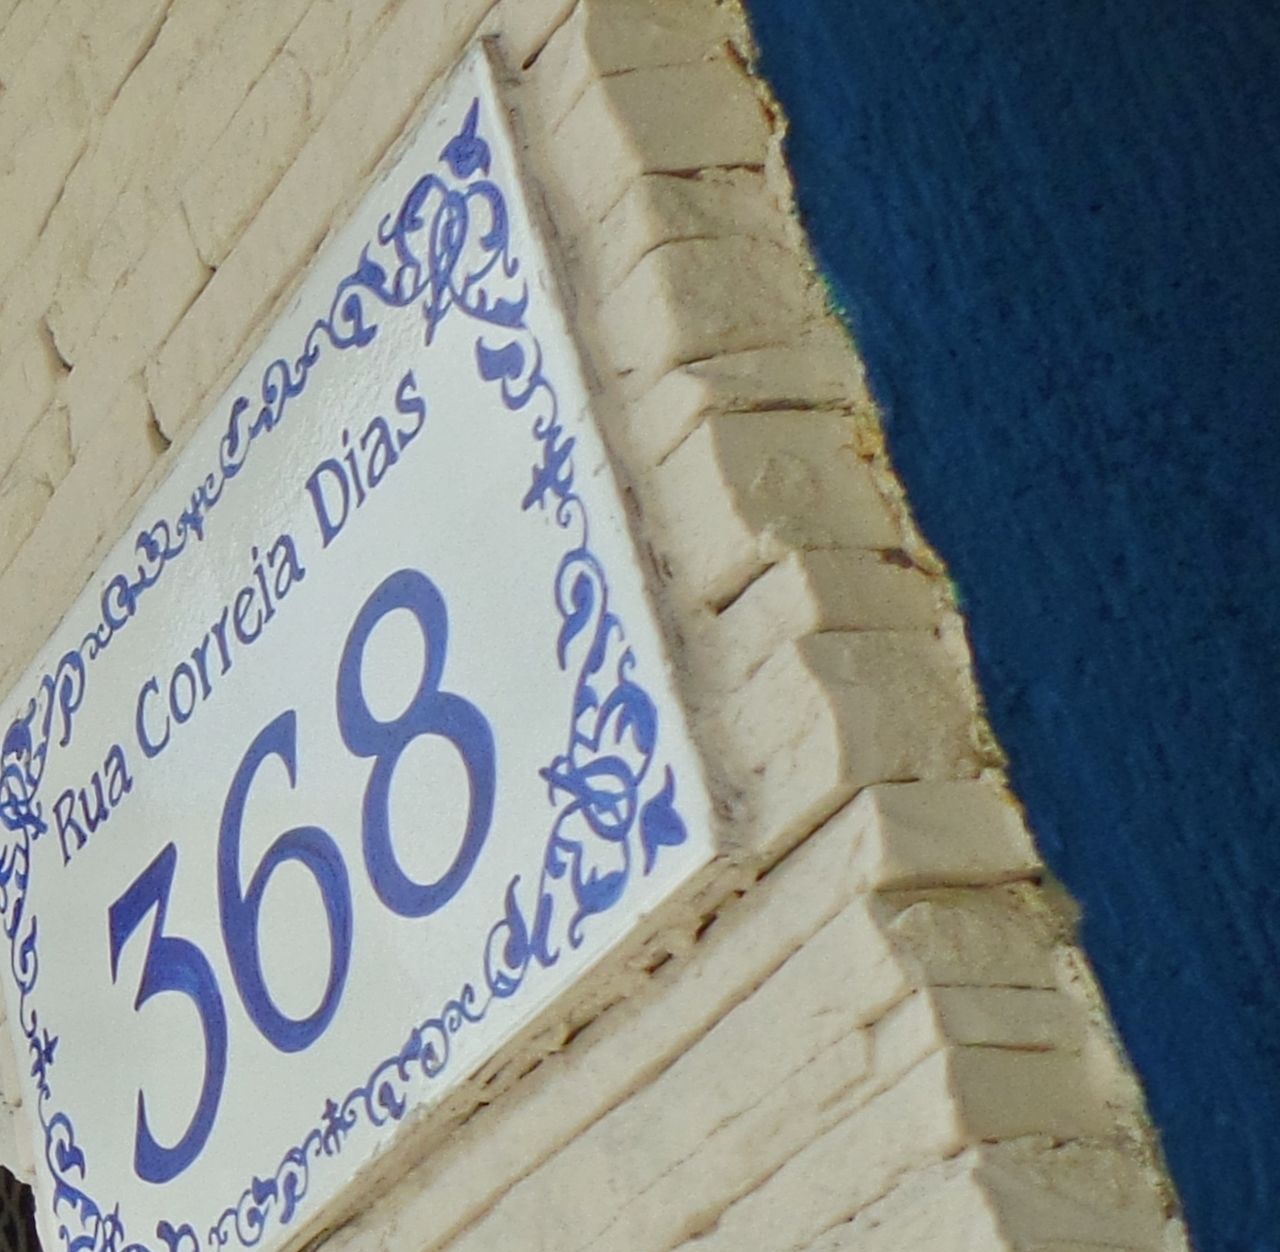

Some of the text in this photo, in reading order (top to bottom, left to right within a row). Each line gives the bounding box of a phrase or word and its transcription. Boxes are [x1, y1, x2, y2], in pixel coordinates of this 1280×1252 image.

[52, 367, 428, 868] Rua Correia Dias
[106, 566, 496, 1185] 368
